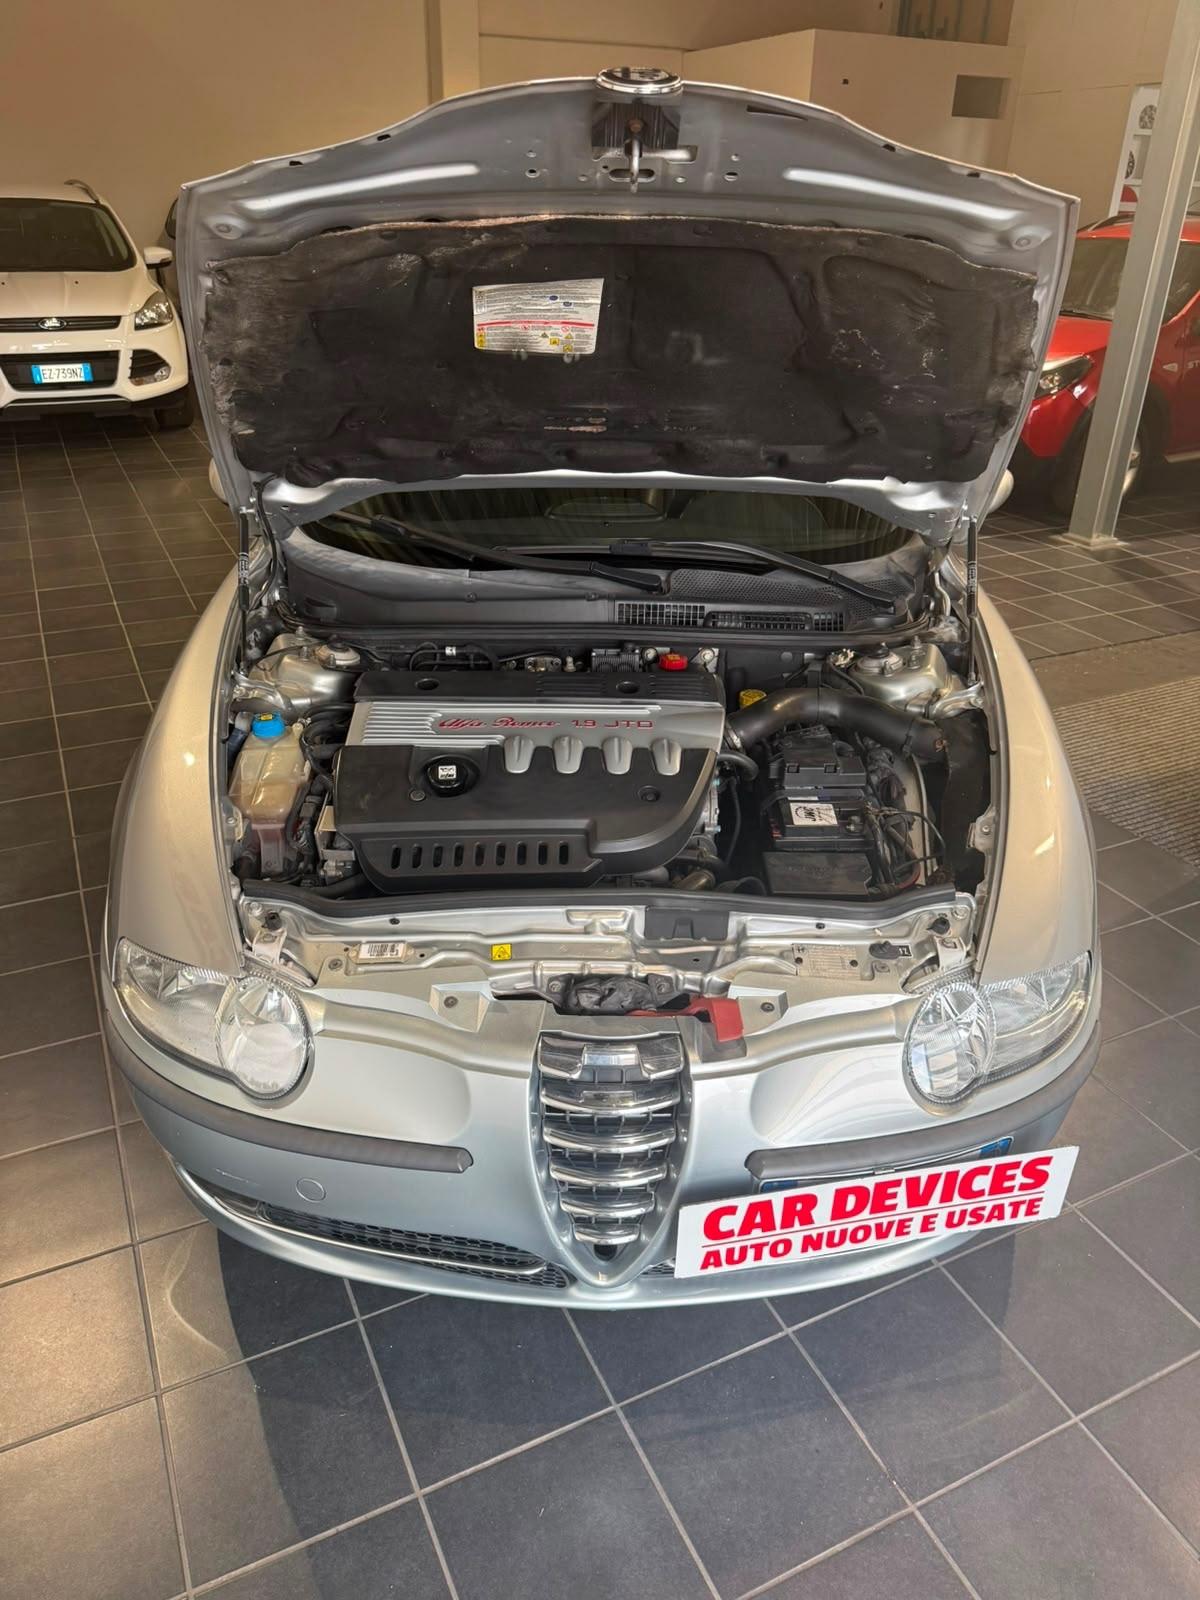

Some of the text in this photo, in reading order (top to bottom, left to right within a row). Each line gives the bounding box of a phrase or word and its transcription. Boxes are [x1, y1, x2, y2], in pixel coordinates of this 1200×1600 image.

[438, 714, 655, 731] Alfa Romeo 1.9 JTD
[700, 1197, 1043, 1270] AUTO NUOVE E USATE
[703, 1156, 1053, 1242] CAR DEVICES
